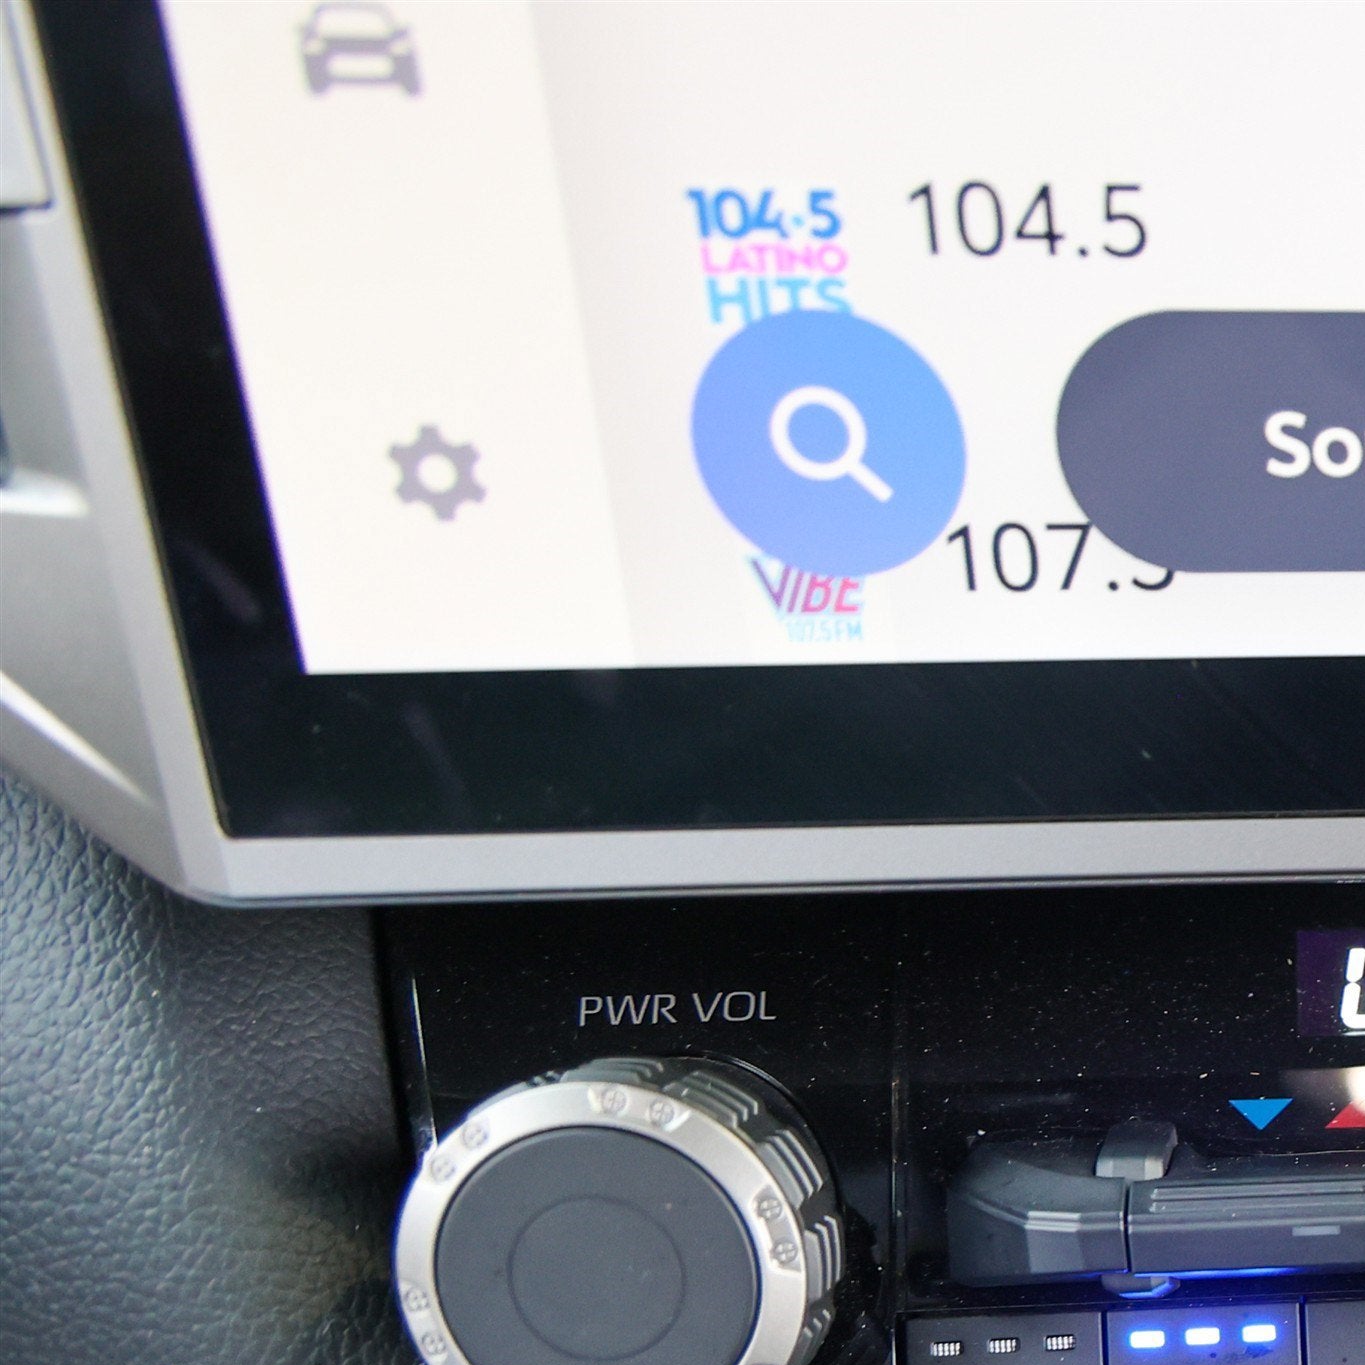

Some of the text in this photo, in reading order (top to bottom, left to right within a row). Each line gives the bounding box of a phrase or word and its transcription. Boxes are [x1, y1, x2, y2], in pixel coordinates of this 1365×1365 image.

[909, 180, 1147, 259] 104.5
[700, 243, 849, 274] LATINO
[706, 277, 853, 324] HITS
[579, 989, 777, 1027] PWR VOL
